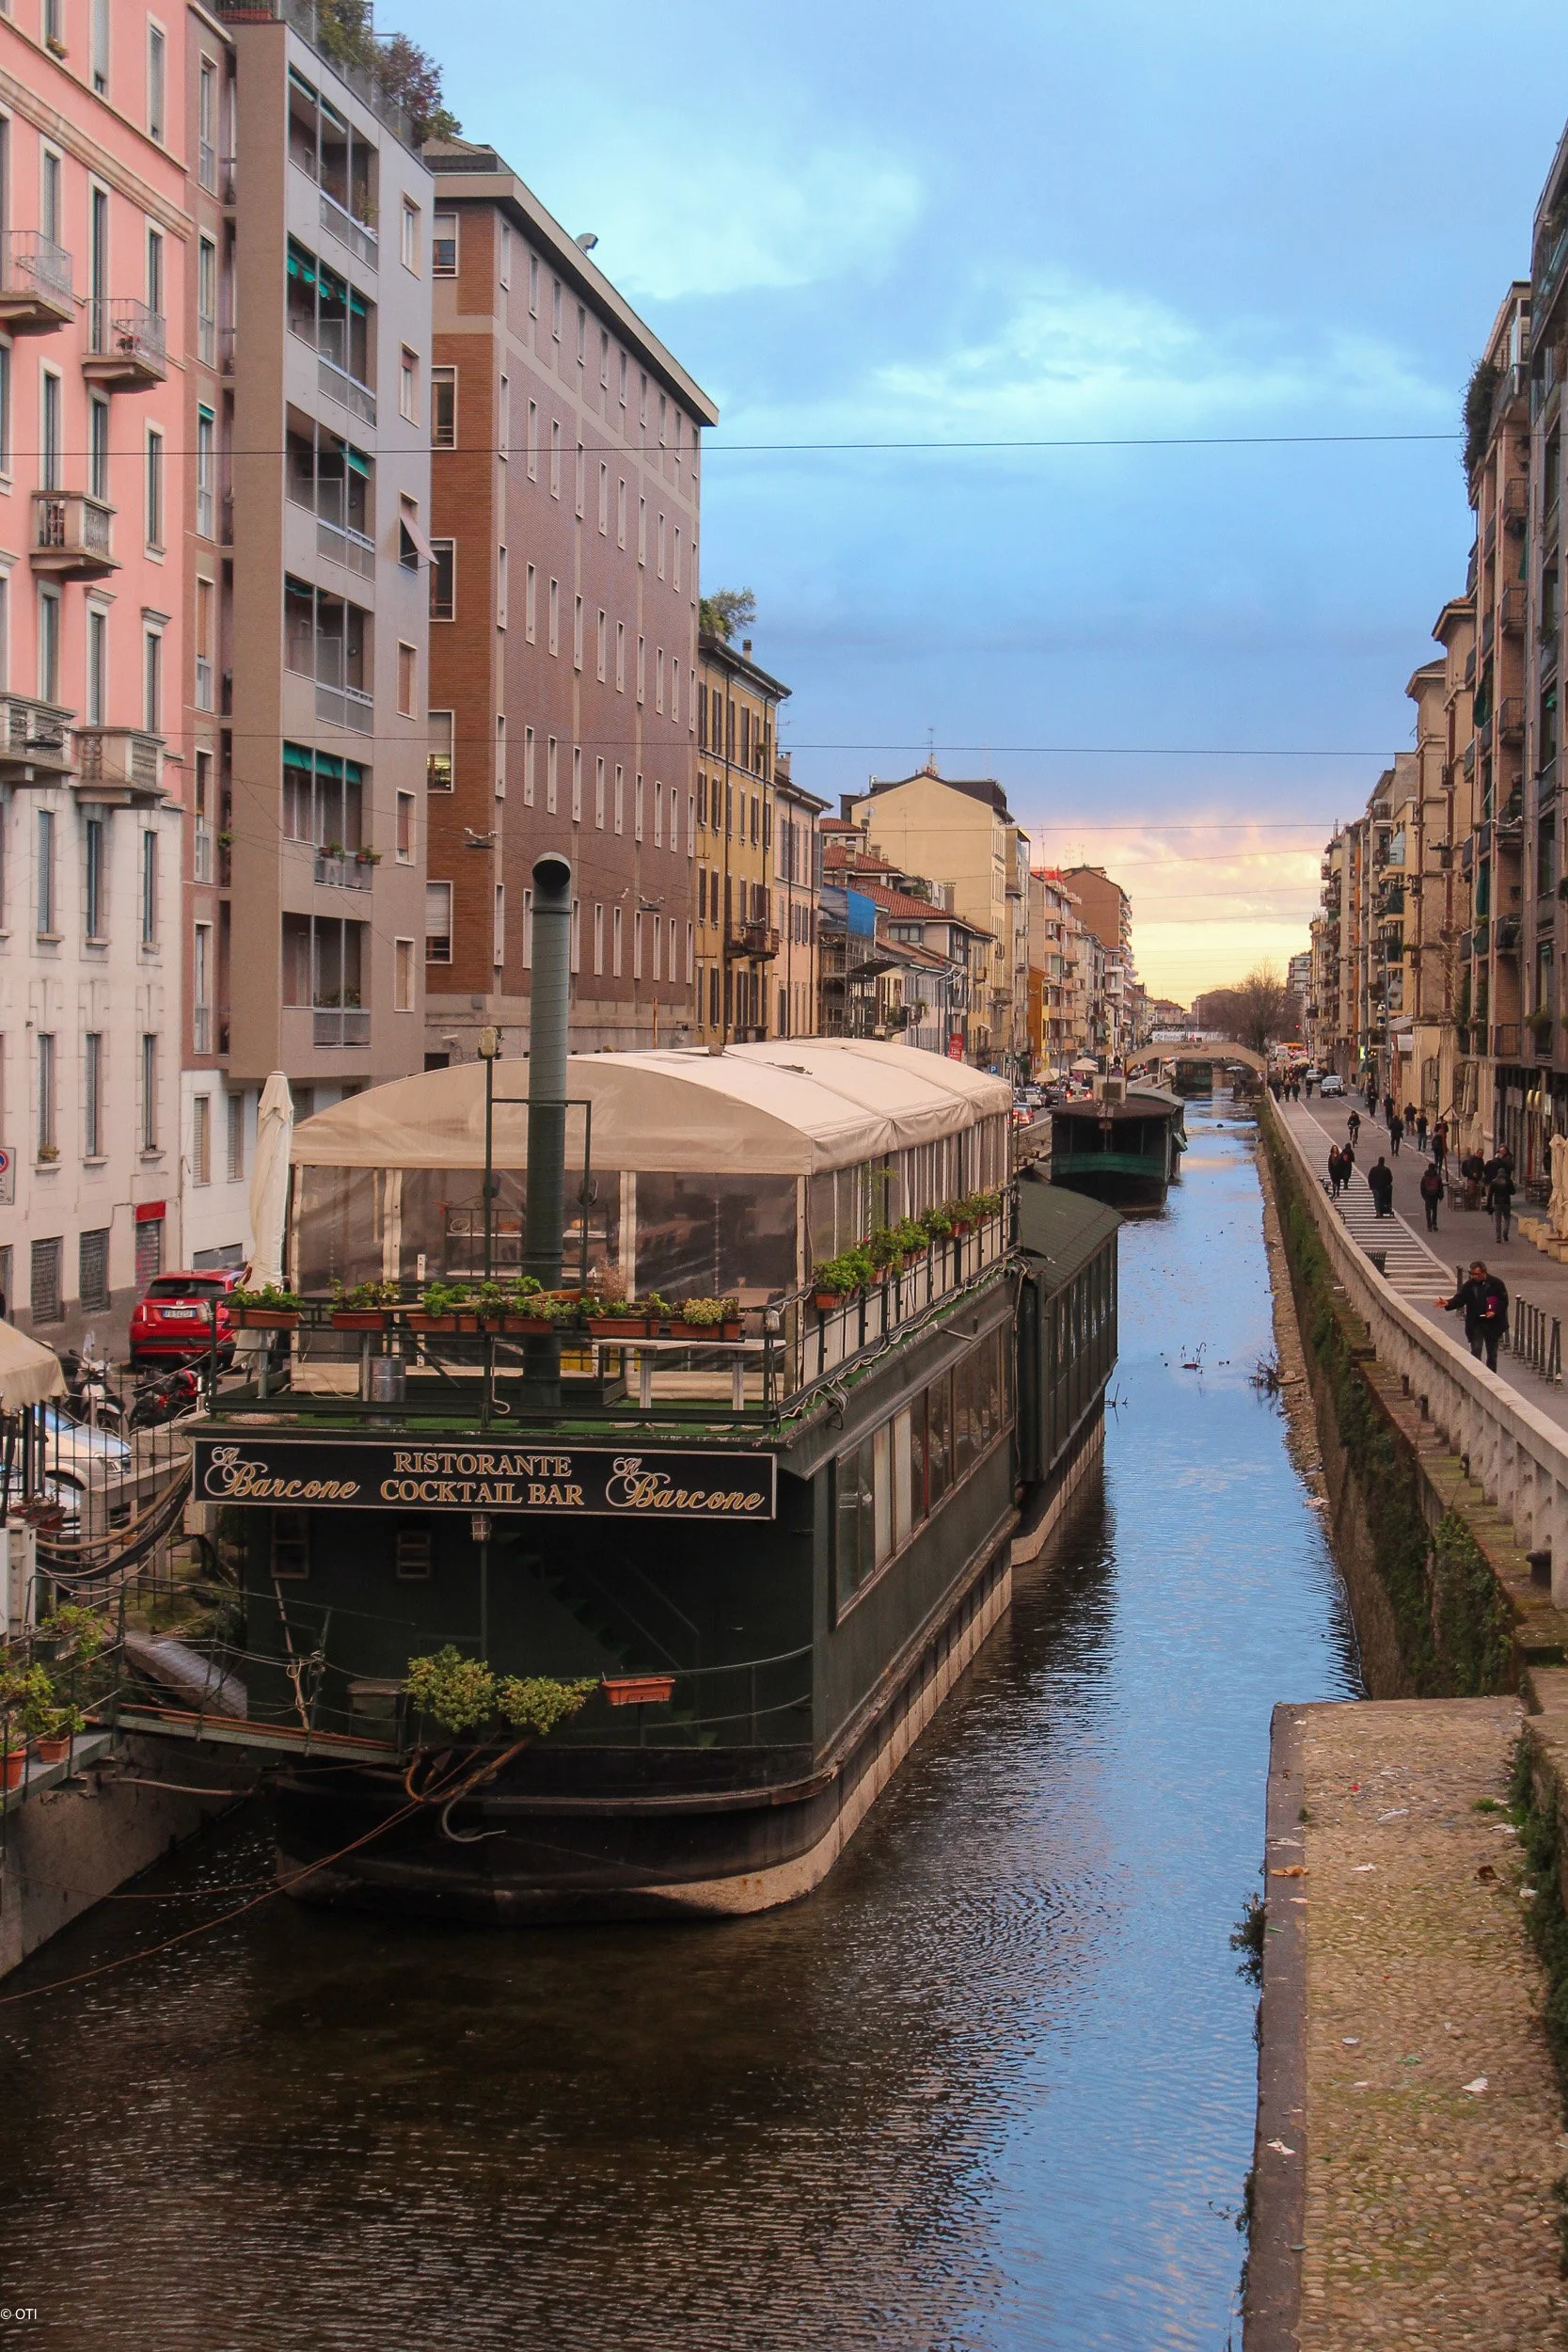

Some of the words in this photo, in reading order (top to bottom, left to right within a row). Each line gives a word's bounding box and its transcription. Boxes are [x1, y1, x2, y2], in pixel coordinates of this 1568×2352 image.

[204, 1460, 361, 1500] Barcone
[393, 1452, 573, 1477] RISTORANTE
[380, 1480, 523, 1503] COCKTAIL
[528, 1484, 585, 1505] BAR
[605, 1471, 766, 1511] Barcone
